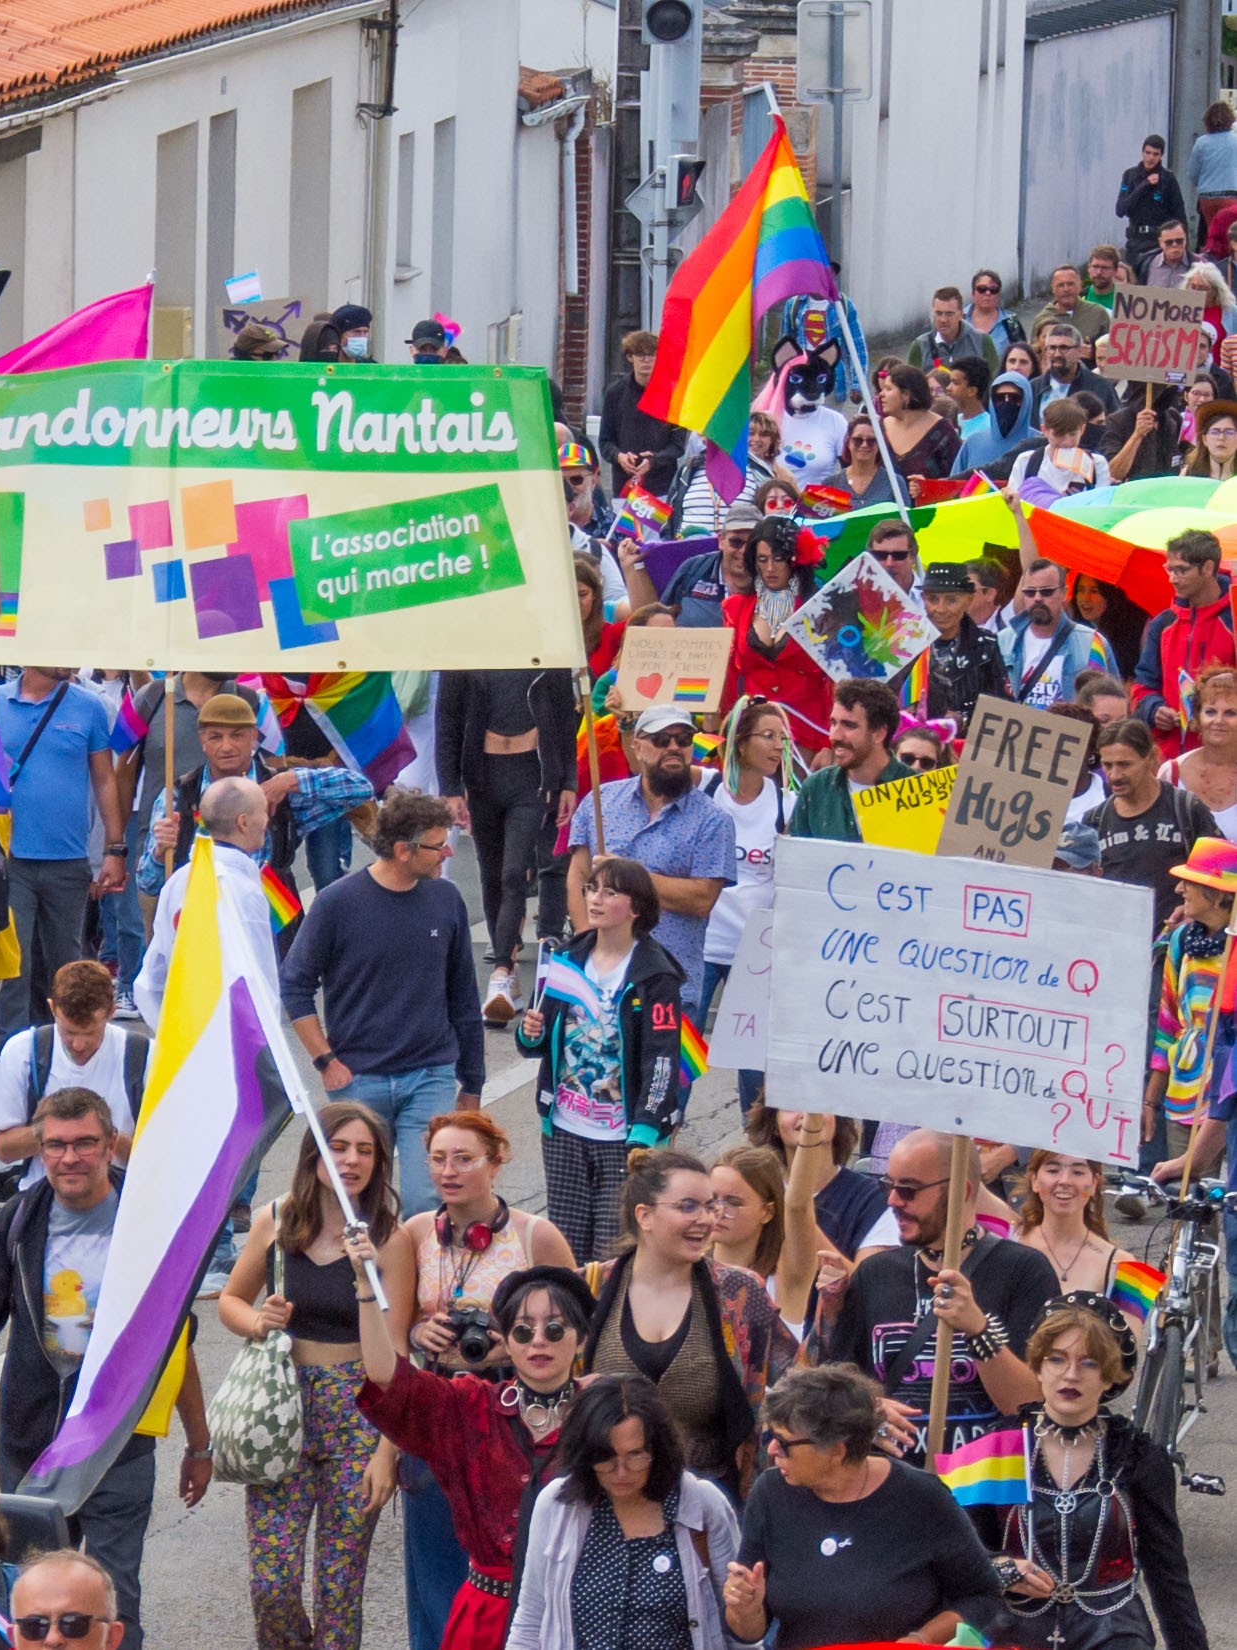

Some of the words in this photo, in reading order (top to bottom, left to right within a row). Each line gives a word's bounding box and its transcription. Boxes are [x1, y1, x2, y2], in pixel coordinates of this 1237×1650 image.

[1113, 292, 1148, 320] NO
[1150, 299, 1203, 323] MORE
[311, 391, 518, 454] Nantais
[310, 513, 481, 562] L'association
[317, 569, 358, 602] qui
[366, 551, 473, 591] marche
[970, 712, 1081, 786] FREE
[954, 776, 1052, 848] Hugs
[974, 845, 1007, 863] AND
[973, 892, 1025, 928] PAS
[1037, 965, 1059, 988] de
[1067, 959, 1100, 998] Q
[652, 1002, 678, 1025] 01
[942, 1001, 1079, 1052] SURTOUT
[1042, 1081, 1058, 1100] de
